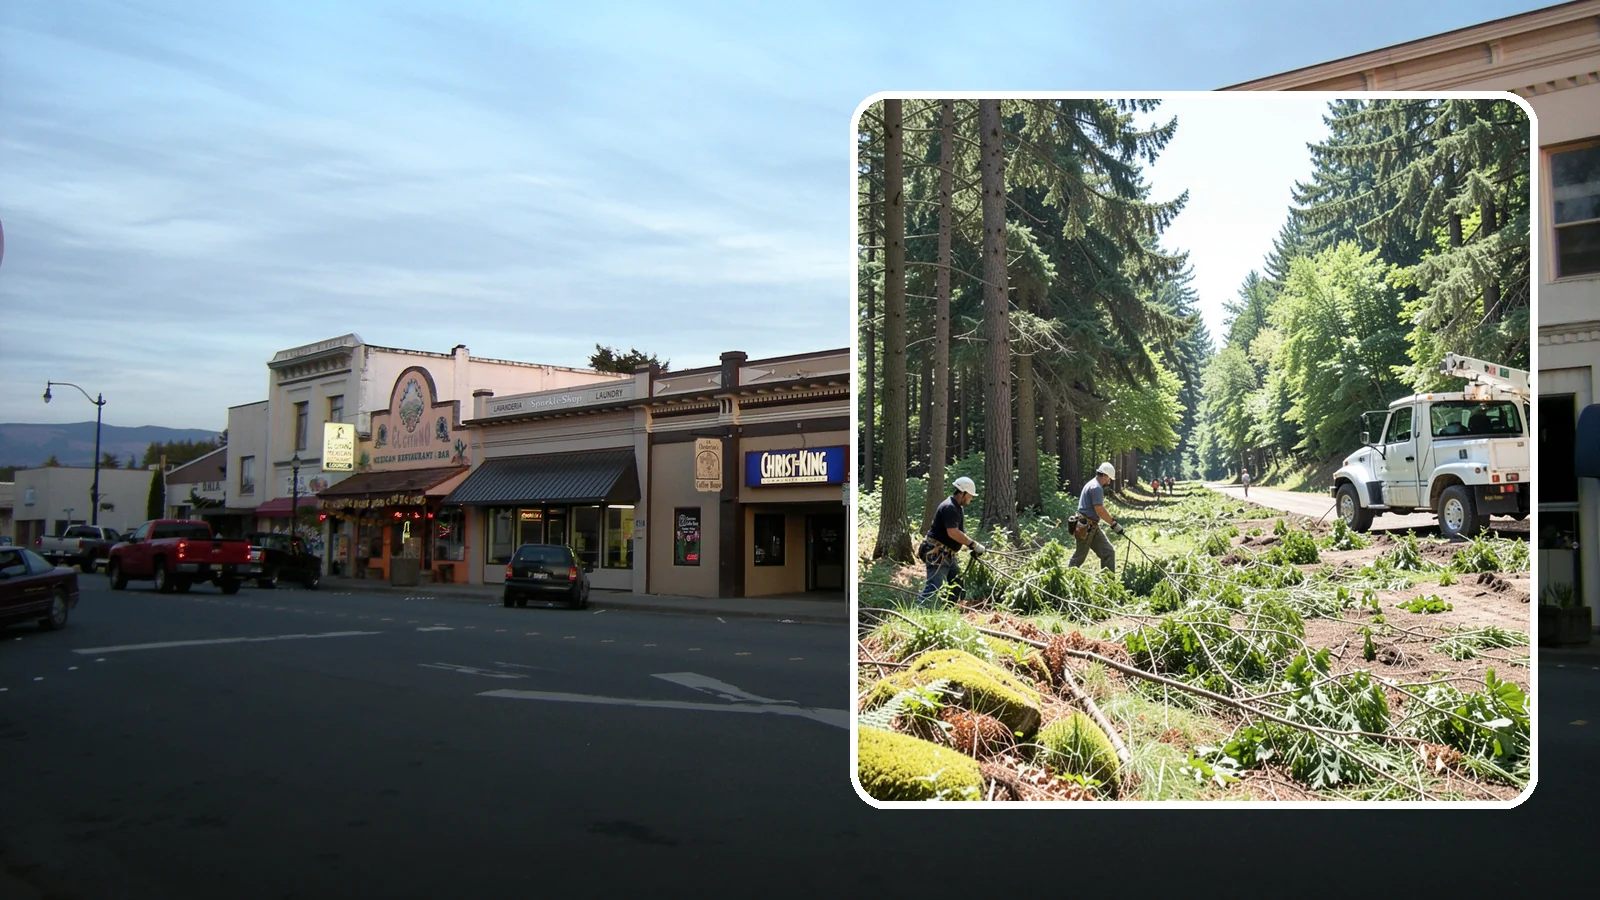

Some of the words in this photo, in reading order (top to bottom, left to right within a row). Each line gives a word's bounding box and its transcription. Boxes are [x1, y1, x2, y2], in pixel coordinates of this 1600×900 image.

[530, 396, 560, 408] Sparkle
[560, 394, 582, 406] Shop
[596, 388, 624, 400] LAUNDRY
[494, 402, 522, 412] LAVANDERIA
[374, 455, 396, 464] MEXICAN
[398, 452, 433, 462] RESTAURANT
[438, 450, 450, 458] BAR
[760, 452, 797, 478] CHRIST
[799, 450, 827, 476] KING
